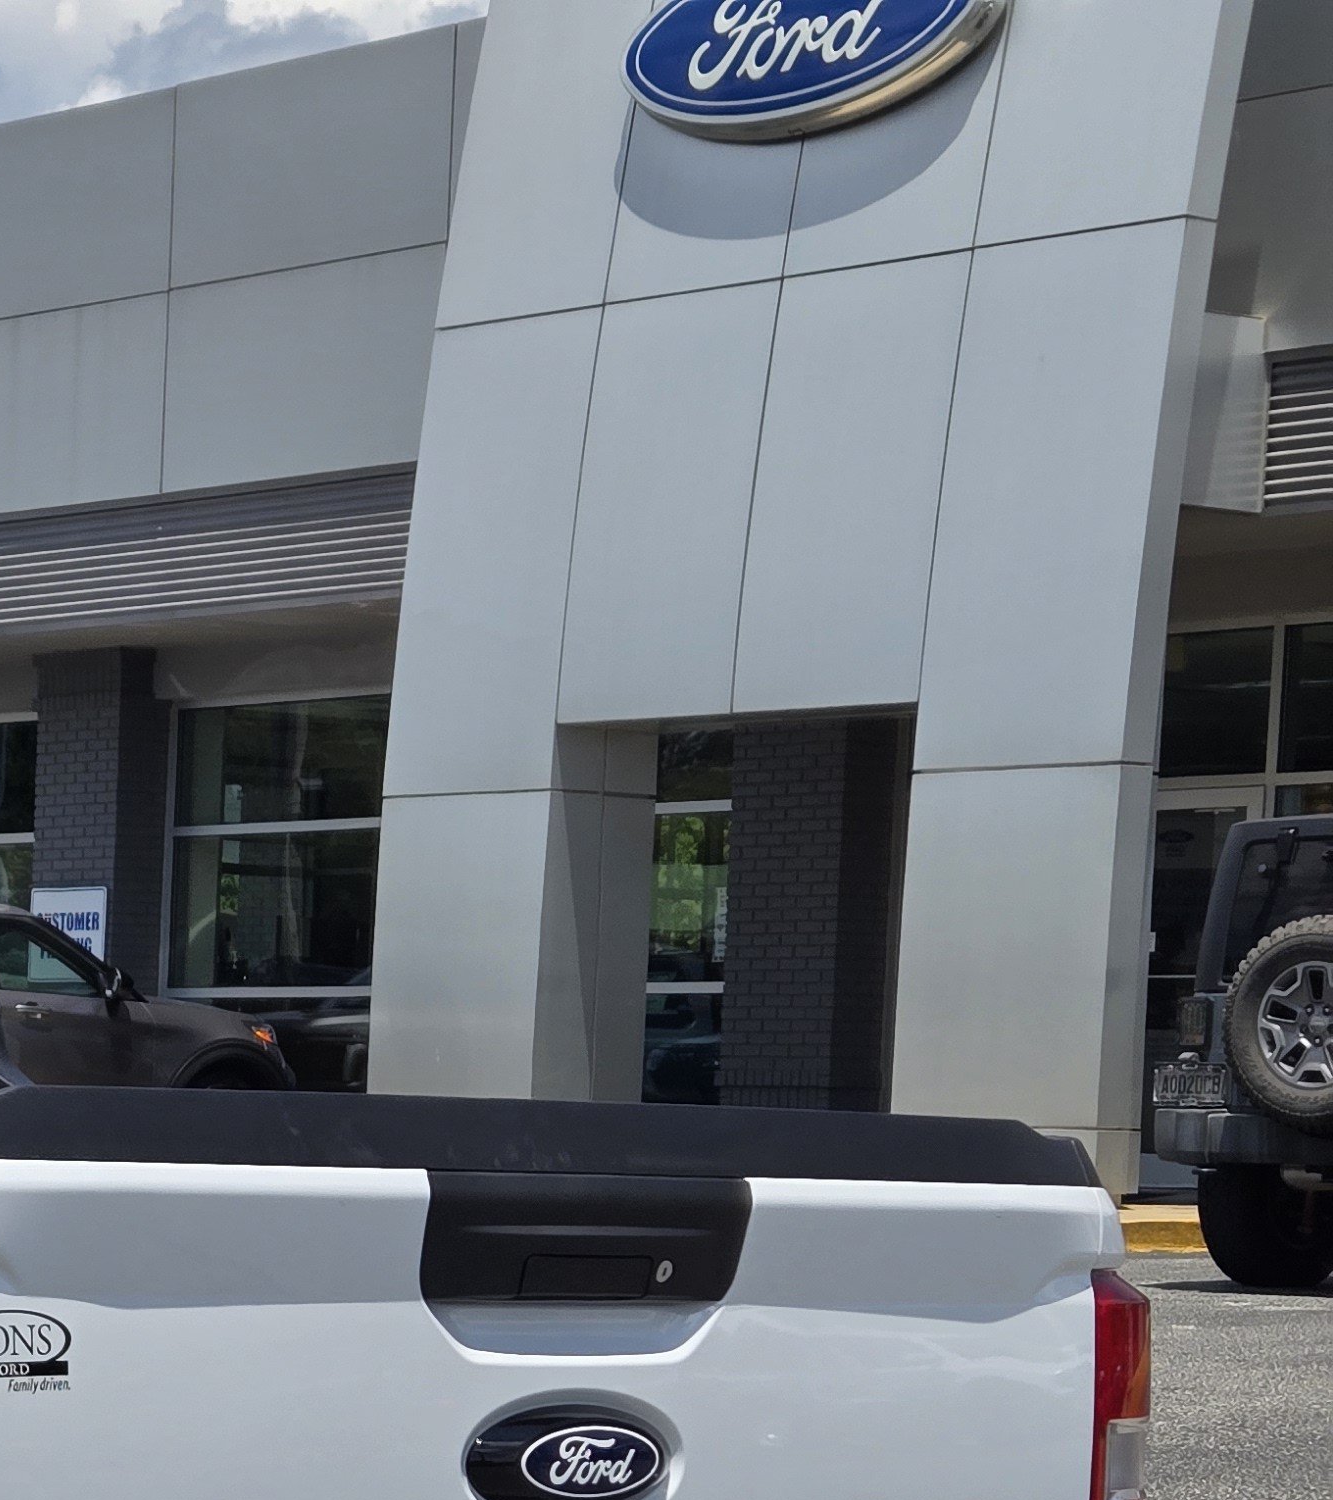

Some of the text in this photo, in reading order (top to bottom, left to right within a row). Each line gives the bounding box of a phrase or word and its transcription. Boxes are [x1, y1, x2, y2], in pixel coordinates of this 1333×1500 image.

[687, 0, 882, 91] Ford
[7, 1377, 71, 1395] Family driven.
[549, 1435, 636, 1486] Ford
